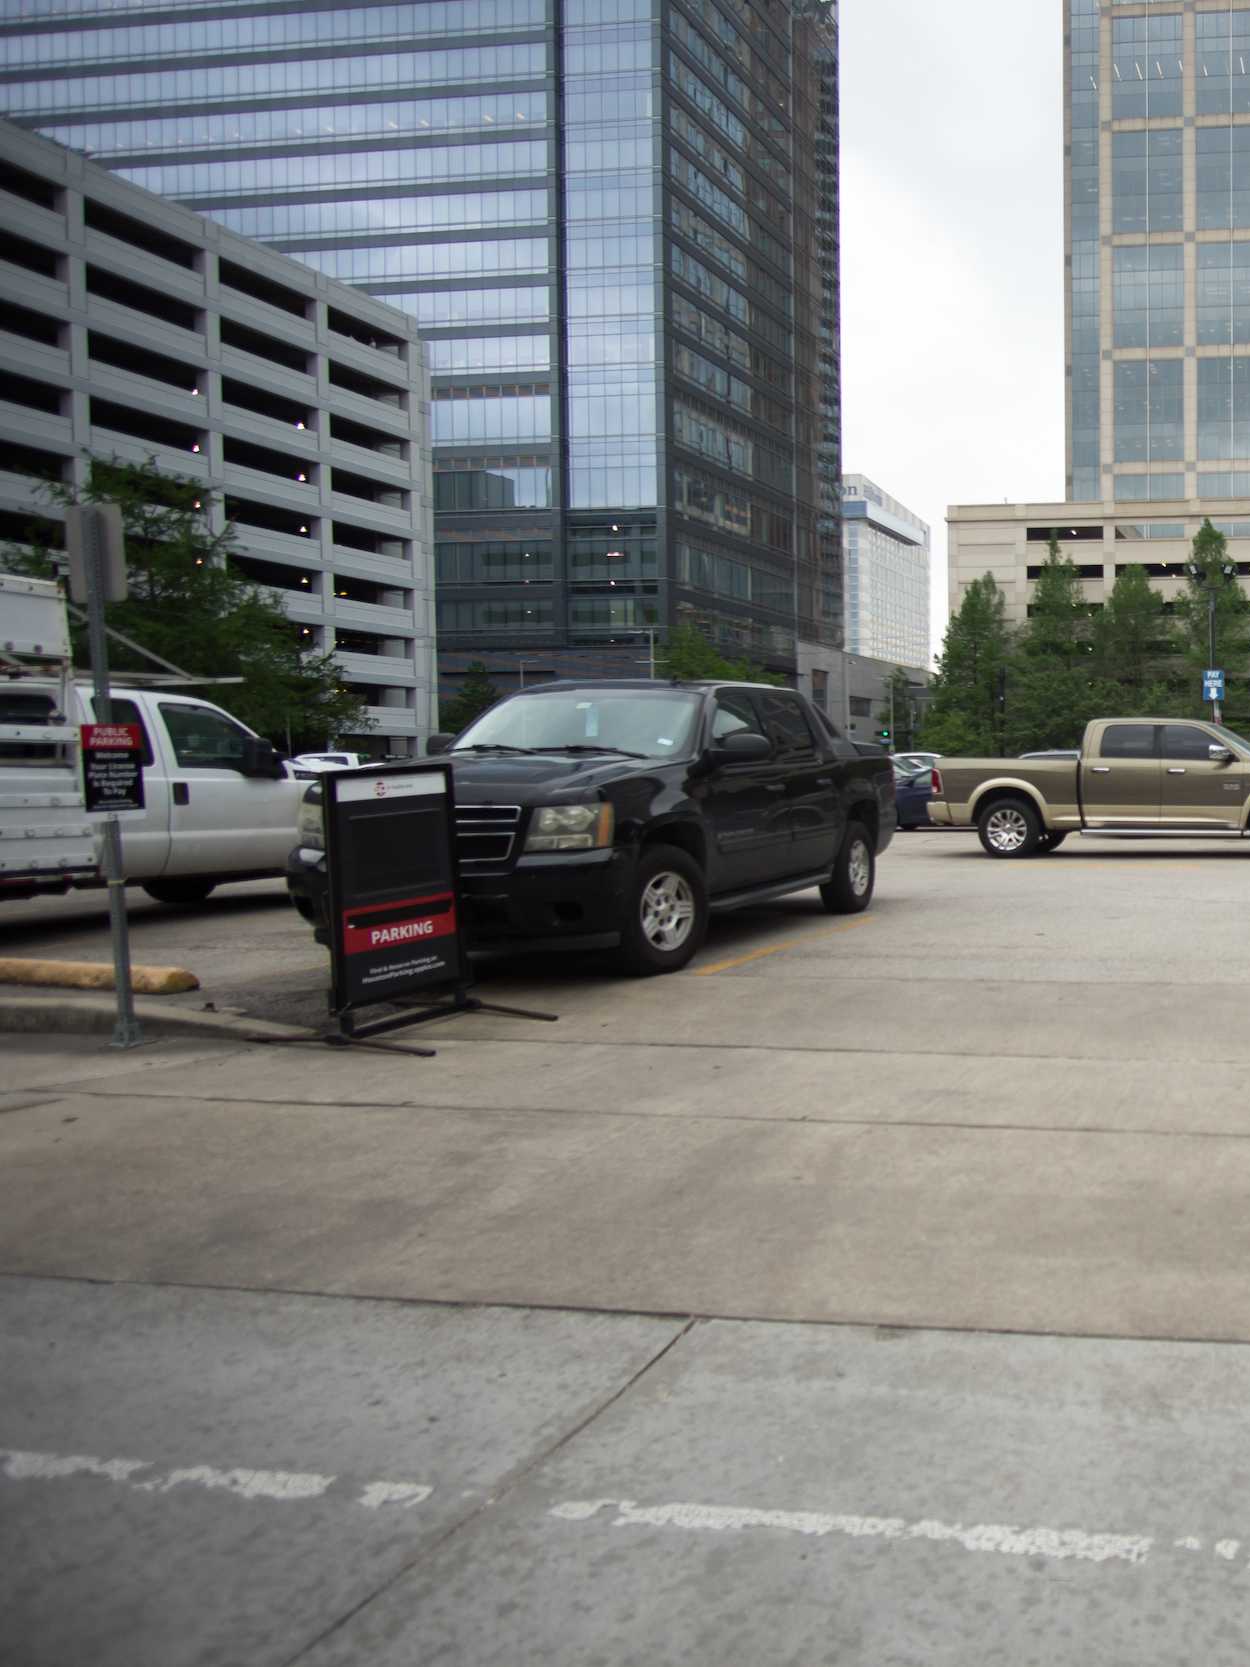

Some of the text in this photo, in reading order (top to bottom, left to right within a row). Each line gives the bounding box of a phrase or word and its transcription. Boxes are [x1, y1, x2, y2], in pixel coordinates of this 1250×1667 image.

[93, 727, 129, 736] PUBLIC
[89, 737, 134, 746] PARKING
[113, 787, 127, 796] Pay
[371, 920, 433, 944] PARKING
